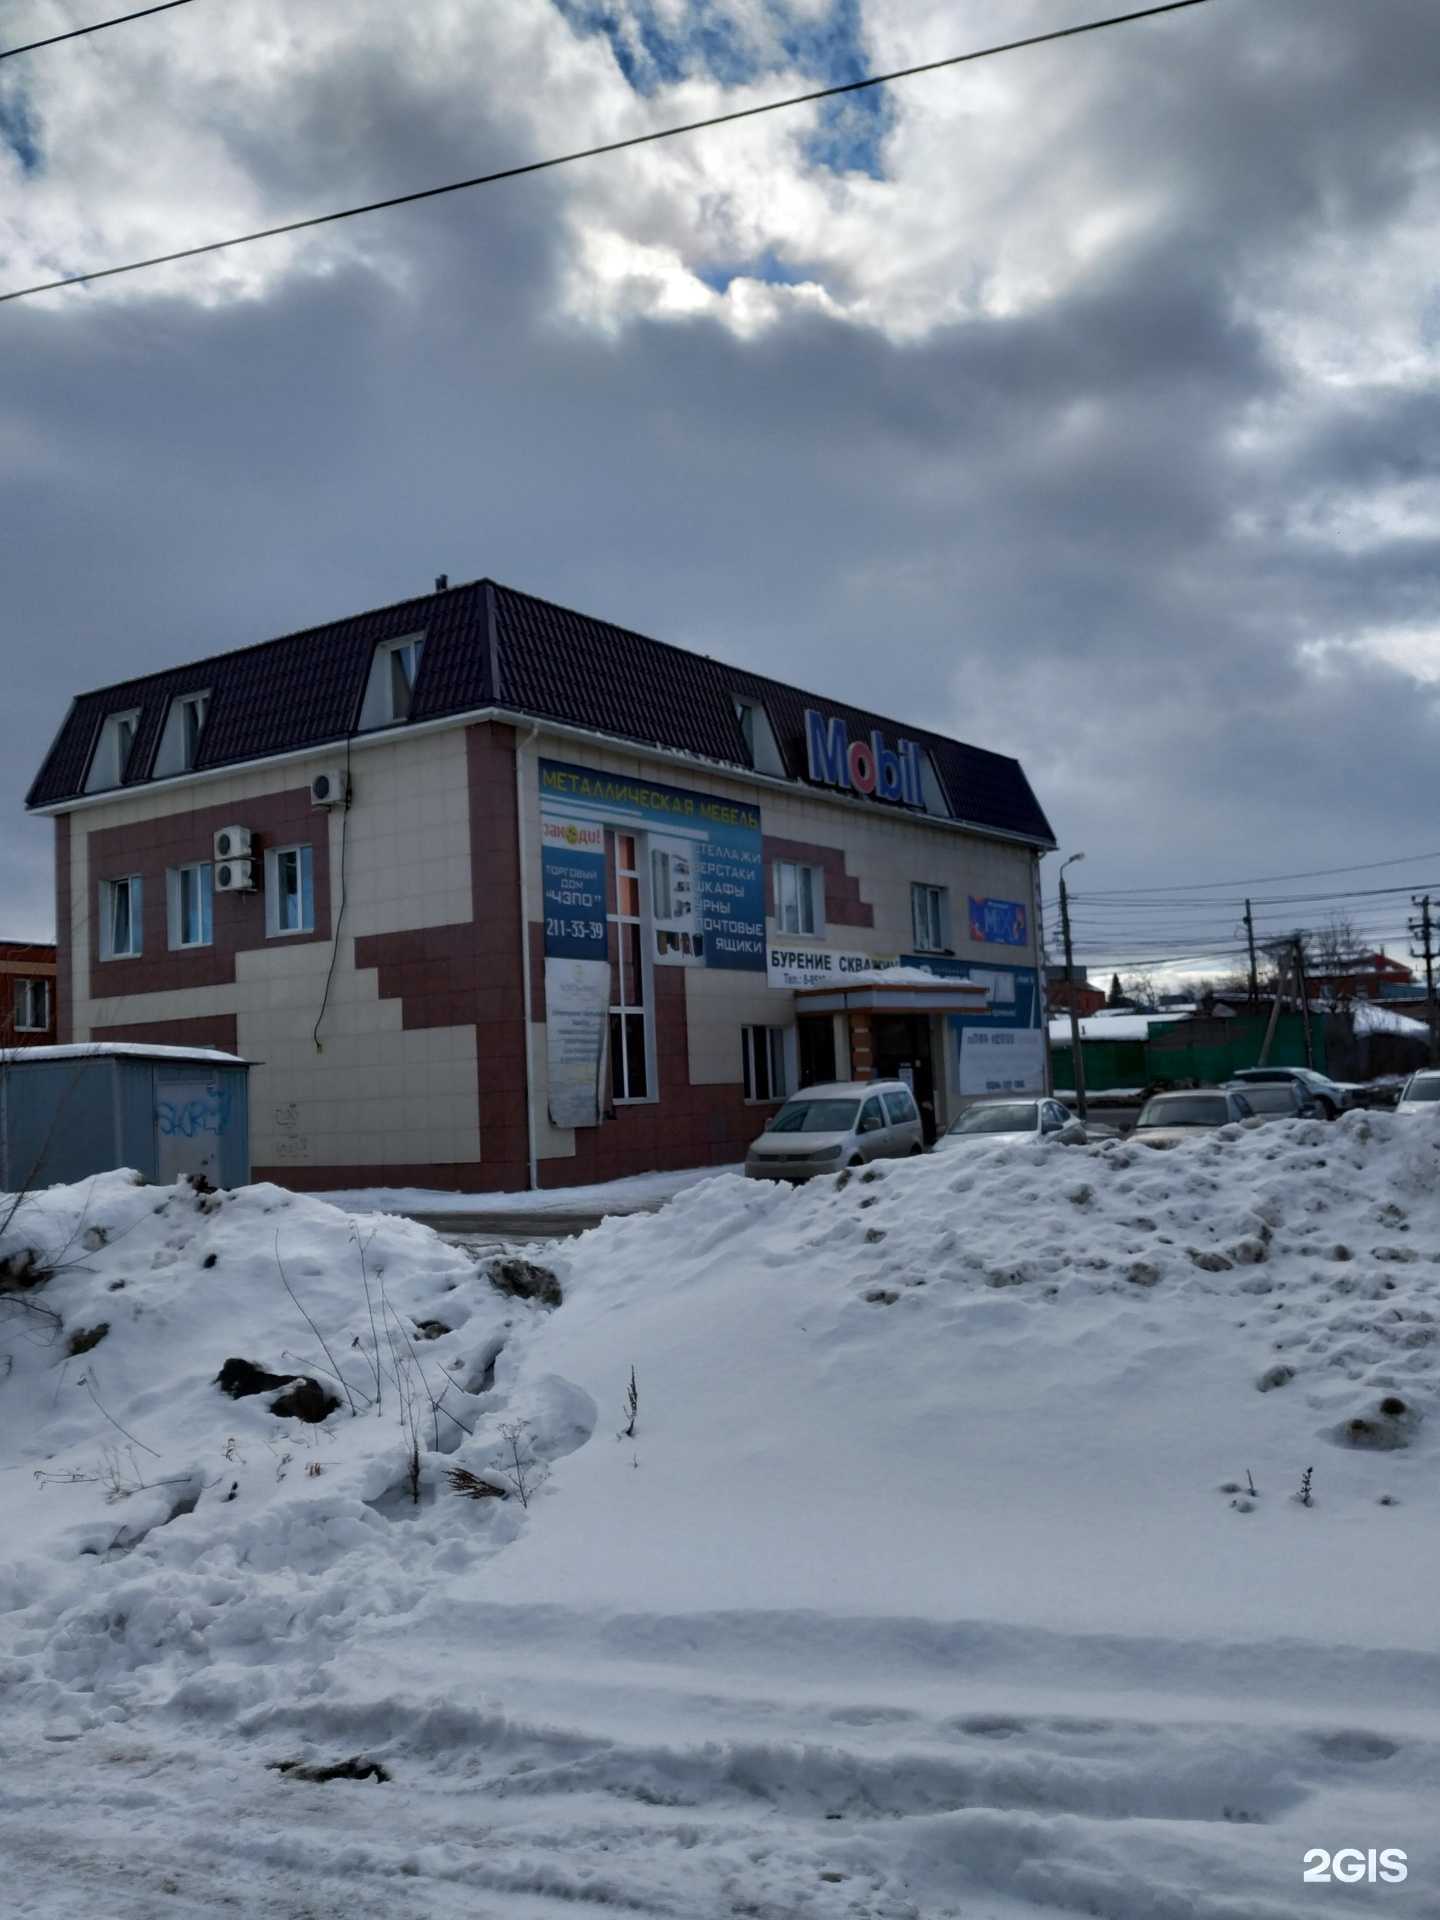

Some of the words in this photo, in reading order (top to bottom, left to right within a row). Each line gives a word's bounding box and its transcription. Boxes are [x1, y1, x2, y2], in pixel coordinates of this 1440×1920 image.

[805, 708, 924, 807] Mobil
[543, 770, 695, 816] МЕТАЛЛИЧЕСКАЯ
[700, 801, 759, 828] МЕБЕЛЬ
[561, 879, 584, 889] ДОМ
[546, 918, 604, 940] 211-33-39
[715, 937, 763, 955] ЯЩИКИ
[771, 950, 832, 971] БУРЕНИЕ
